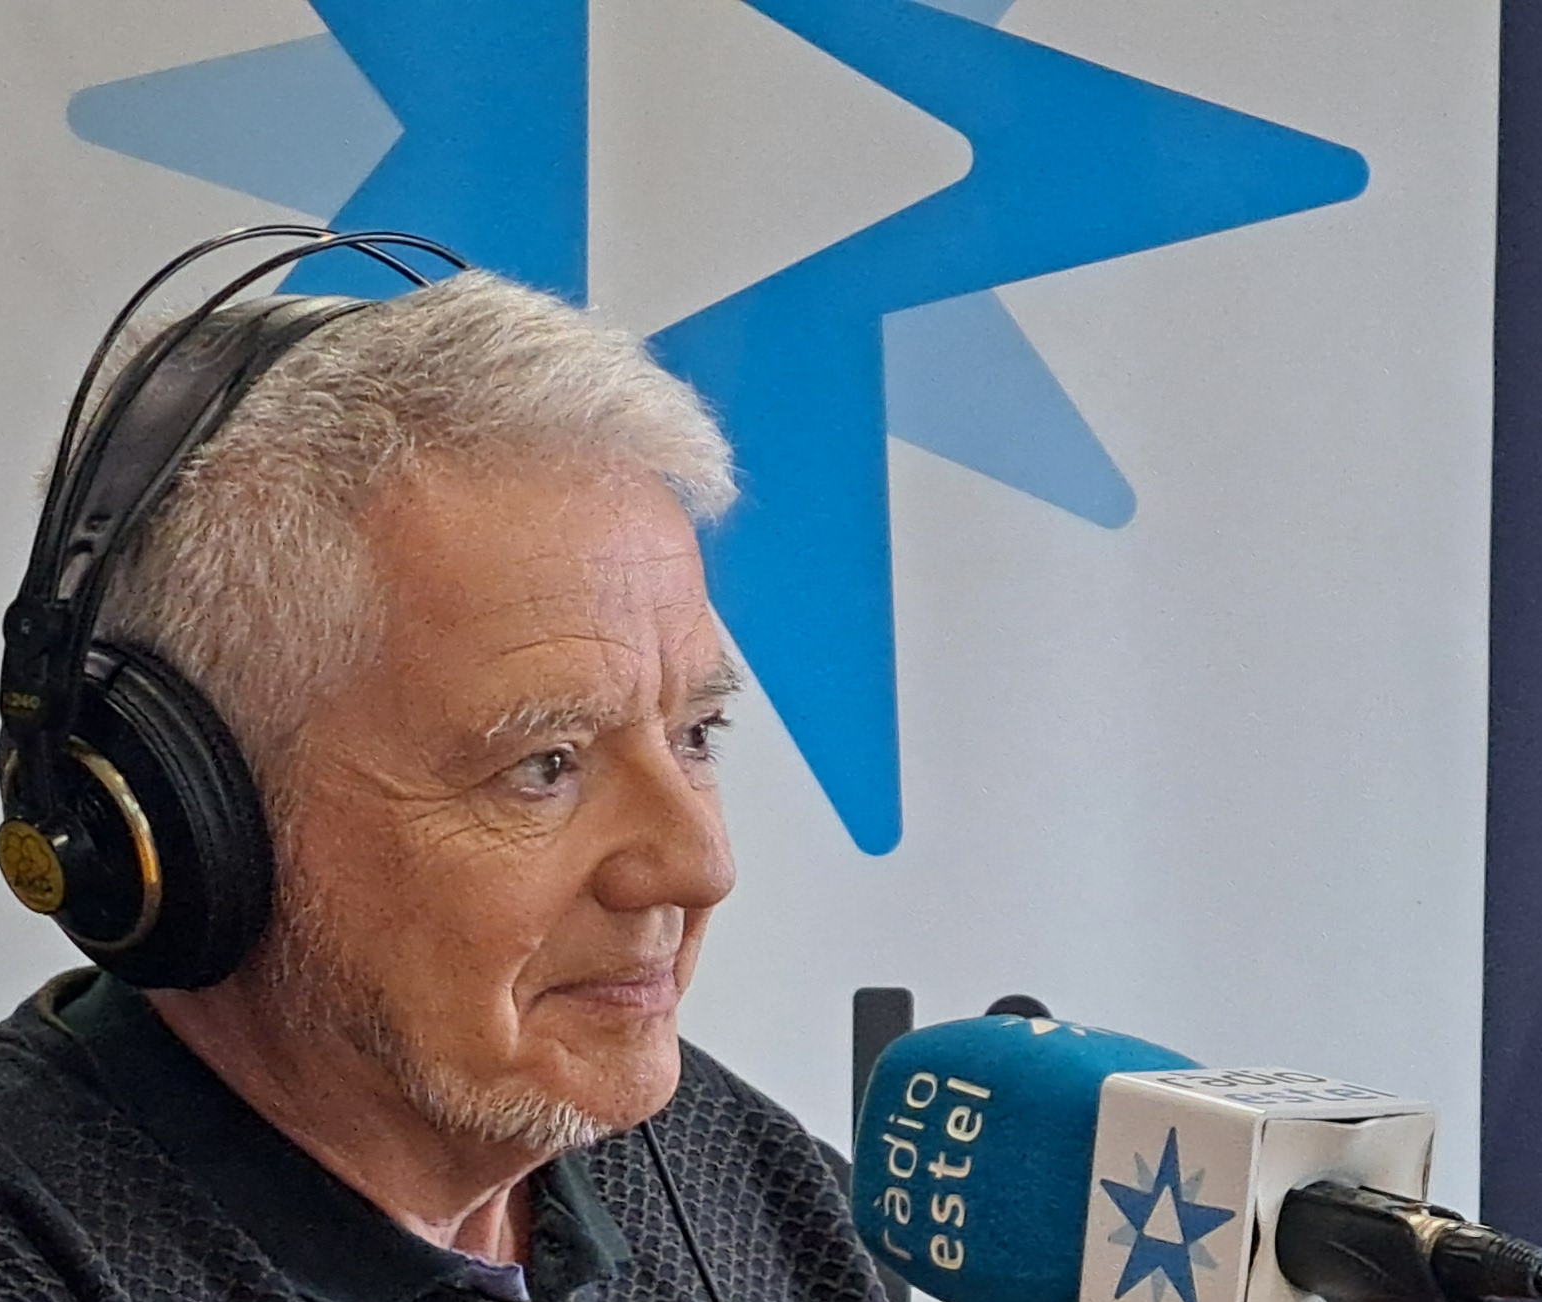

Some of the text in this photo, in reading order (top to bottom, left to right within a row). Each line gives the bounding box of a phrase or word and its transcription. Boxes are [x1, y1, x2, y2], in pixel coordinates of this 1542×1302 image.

[873, 1071, 938, 1261] ràdio
[928, 1077, 992, 1271] estel
[1224, 1083, 1398, 1105] estel
